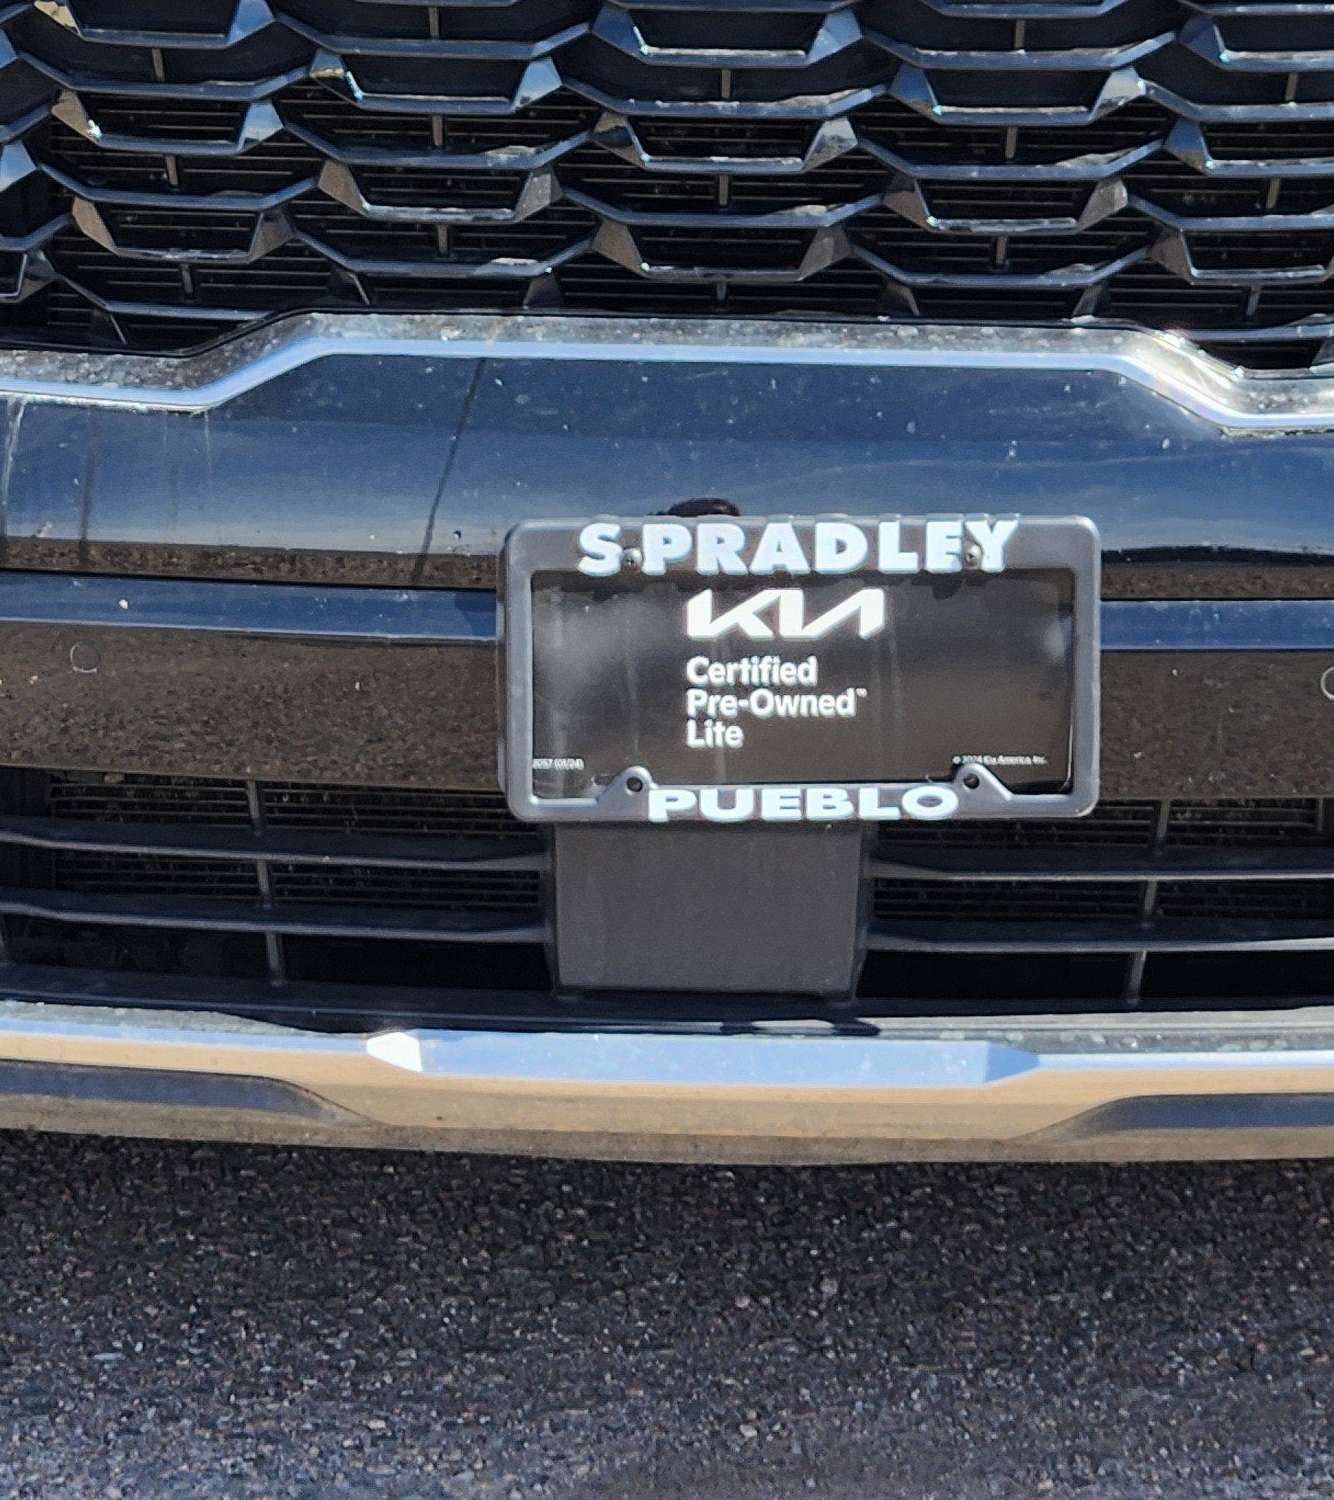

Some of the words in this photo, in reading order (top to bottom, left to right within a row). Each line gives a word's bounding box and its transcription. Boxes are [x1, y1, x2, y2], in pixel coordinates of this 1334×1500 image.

[576, 517, 1021, 577] SPRADLEY
[686, 587, 887, 641] KIA
[685, 655, 819, 686] Certified
[685, 719, 745, 749] Lite
[647, 785, 960, 823] PUEBLO
